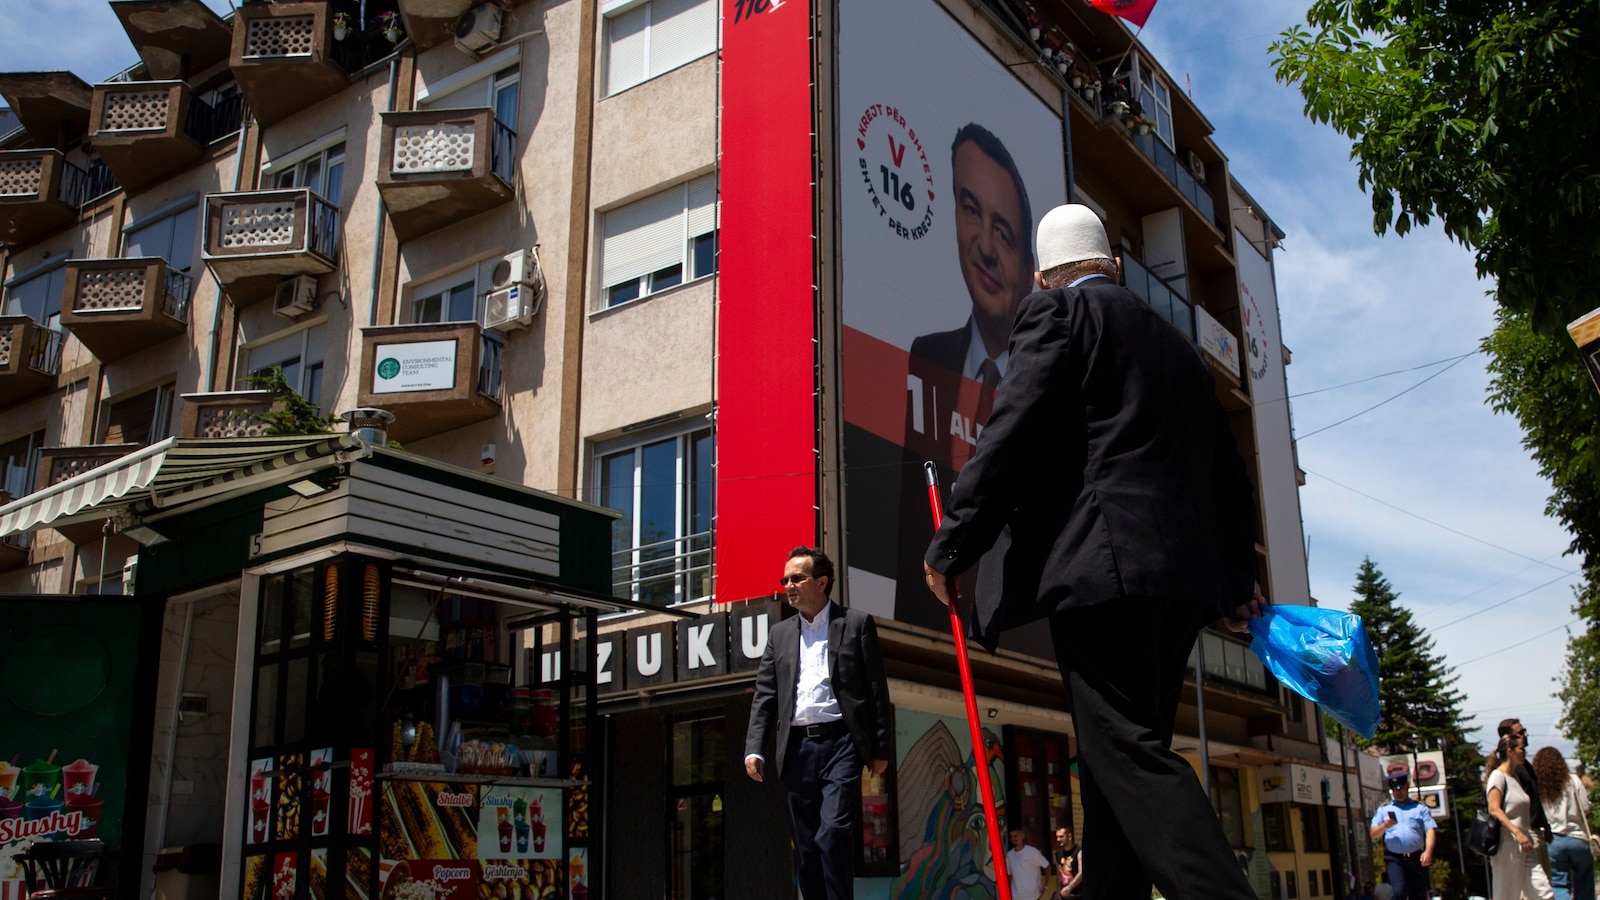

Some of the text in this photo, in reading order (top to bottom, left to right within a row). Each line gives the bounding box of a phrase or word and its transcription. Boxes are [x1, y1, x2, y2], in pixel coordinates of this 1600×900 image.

[858, 104, 934, 186] KREJT PËR SHTET
[888, 133, 906, 168] V
[859, 157, 934, 240] SHTET PËR KREJT
[880, 164, 915, 211] 116
[402, 356, 452, 365] ENVIRONMENTAL
[907, 374, 925, 435] 1
[254, 534, 261, 554] 5
[485, 795, 513, 809] Slushy
[0, 811, 82, 841] Slushy
[434, 866, 470, 881] Popcorn
